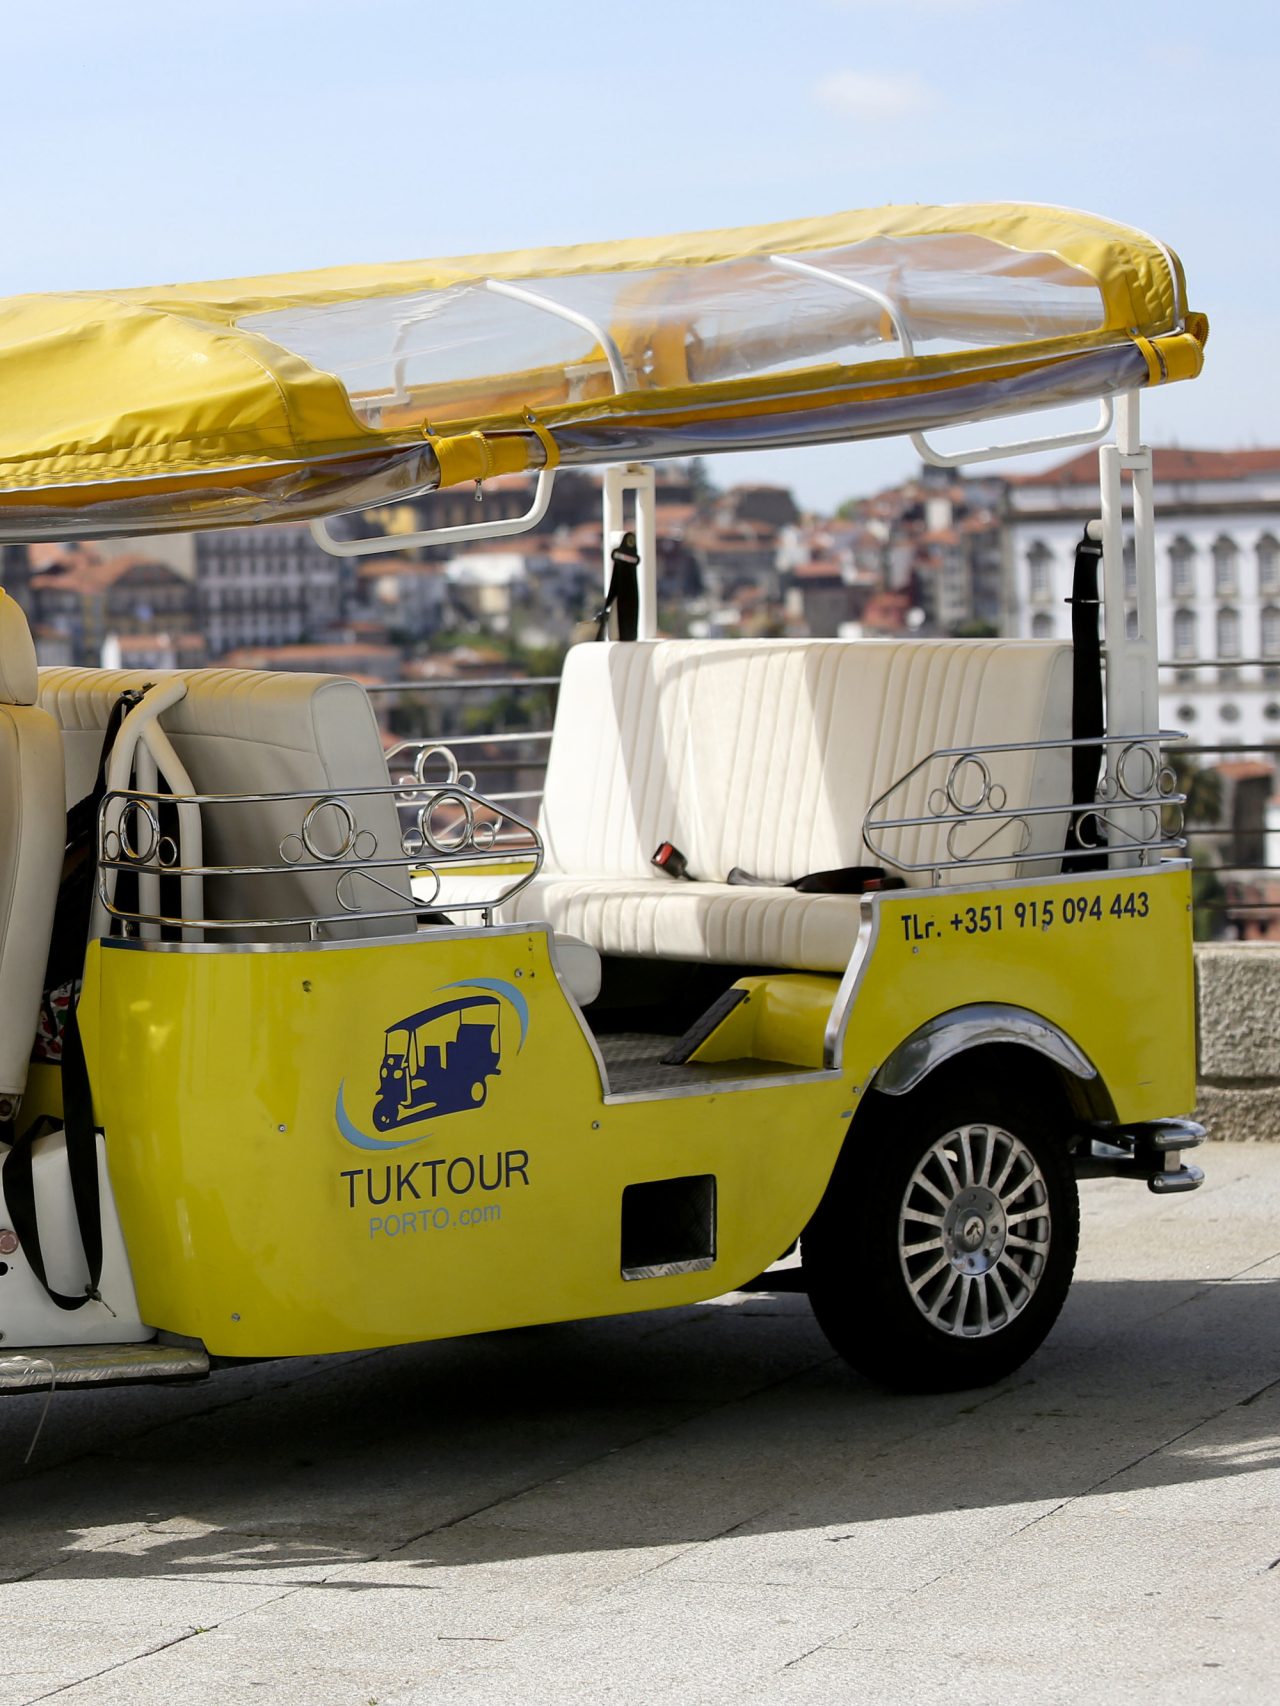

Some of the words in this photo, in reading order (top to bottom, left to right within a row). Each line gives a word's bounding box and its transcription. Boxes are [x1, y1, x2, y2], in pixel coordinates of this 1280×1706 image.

[950, 905, 1002, 934] +351
[1014, 900, 1054, 928] 915
[1062, 896, 1103, 924] 094
[1109, 892, 1150, 919] 443
[340, 1150, 530, 1208] TUKTOUR
[369, 1204, 502, 1239] PORTO.com
